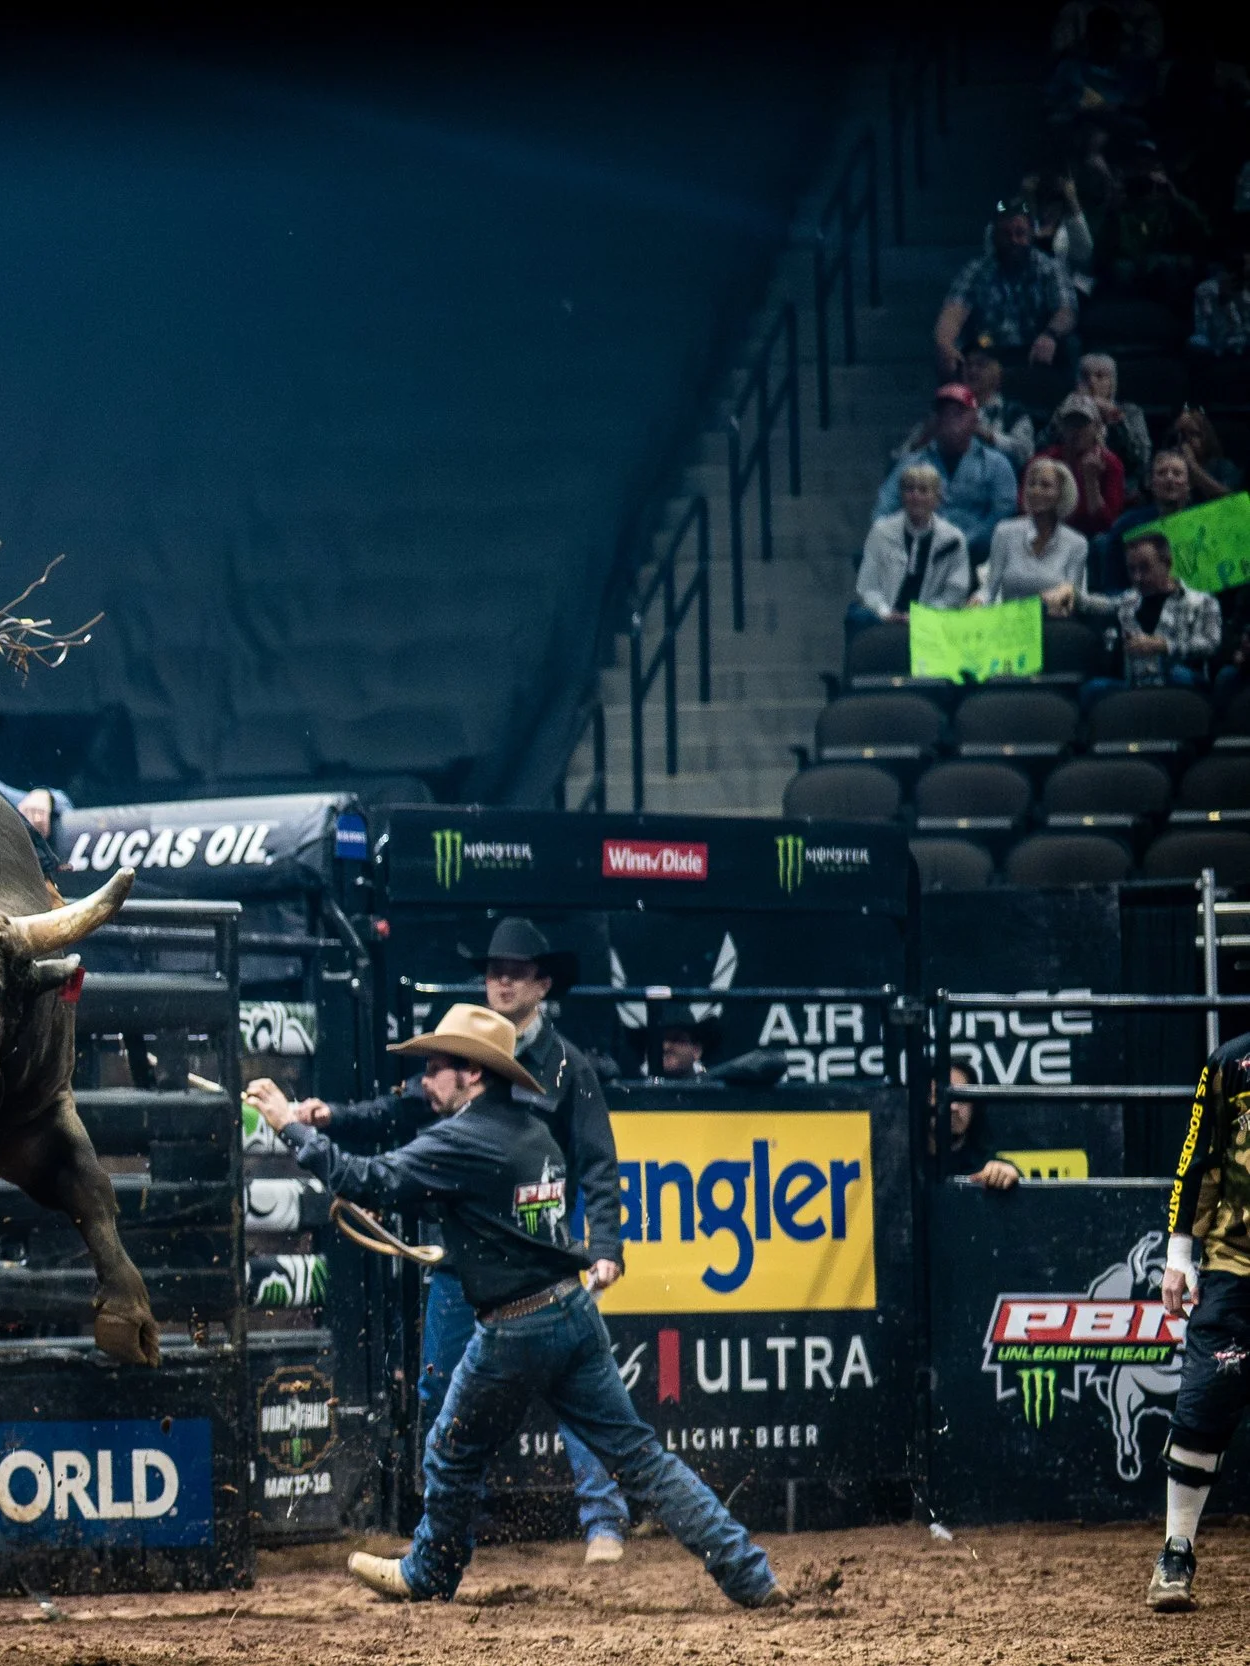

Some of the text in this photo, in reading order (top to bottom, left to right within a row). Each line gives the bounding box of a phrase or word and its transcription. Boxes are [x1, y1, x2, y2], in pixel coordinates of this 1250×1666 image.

[68, 825, 201, 872] LUCAS
[463, 840, 533, 862] MONSTER
[759, 1003, 863, 1046] AIR
[696, 1334, 874, 1393] ULTRA
[998, 1345, 1081, 1361] UNLEASH
[667, 1424, 819, 1451] LIGHT BEER
